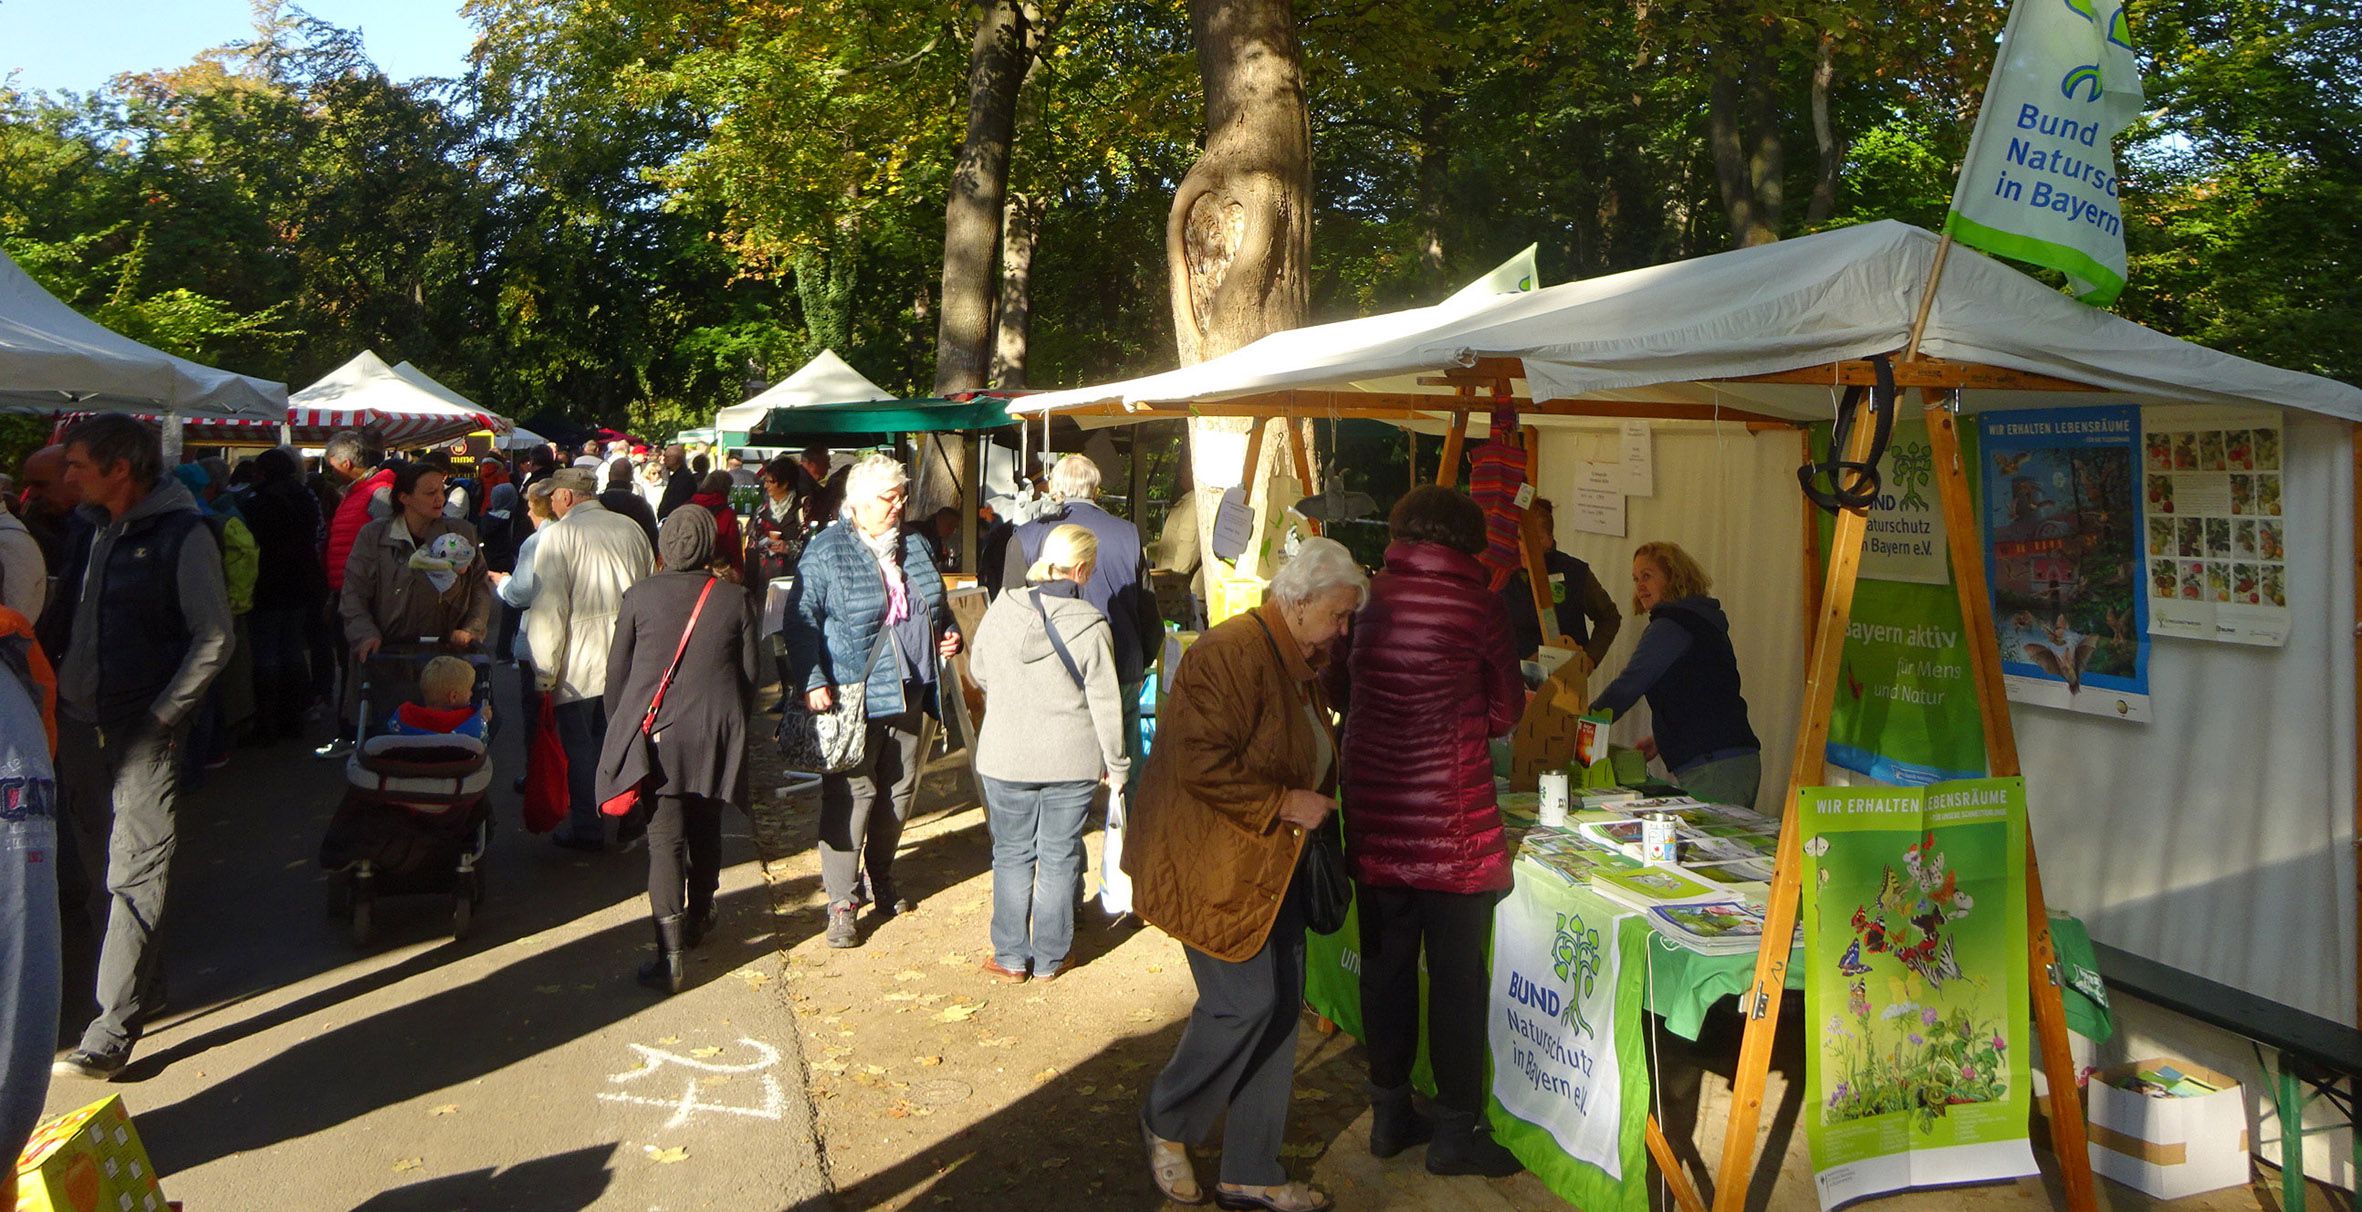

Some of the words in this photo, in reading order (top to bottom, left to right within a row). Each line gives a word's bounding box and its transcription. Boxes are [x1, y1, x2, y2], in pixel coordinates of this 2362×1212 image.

[2017, 103, 2099, 147] Bund
[2006, 137, 2117, 197] Natursc
[1995, 171, 2022, 201] in
[2030, 181, 2120, 236] Bayern
[1989, 424, 2005, 436] WIR
[2007, 421, 2050, 435] ERHALTEN
[2055, 418, 2130, 434] LEBENSRÄUME
[1868, 495, 1896, 511] ND
[1867, 518, 1931, 534] aturschutz
[1871, 537, 1910, 557] Bayern
[1913, 540, 1933, 556] e.V.
[1907, 624, 1958, 649] aktiv
[1897, 656, 1914, 679] für
[1917, 661, 1962, 680] Mens
[1873, 683, 1899, 700] und
[1901, 684, 1946, 705] Natur
[1816, 798, 1841, 814] WIR
[1848, 798, 1920, 814] ERHALTEN
[1508, 970, 1560, 1018] BUND
[1507, 1007, 1593, 1079] Naturschutz
[1513, 1041, 1524, 1070] in
[1525, 1051, 1571, 1100] Bayern
